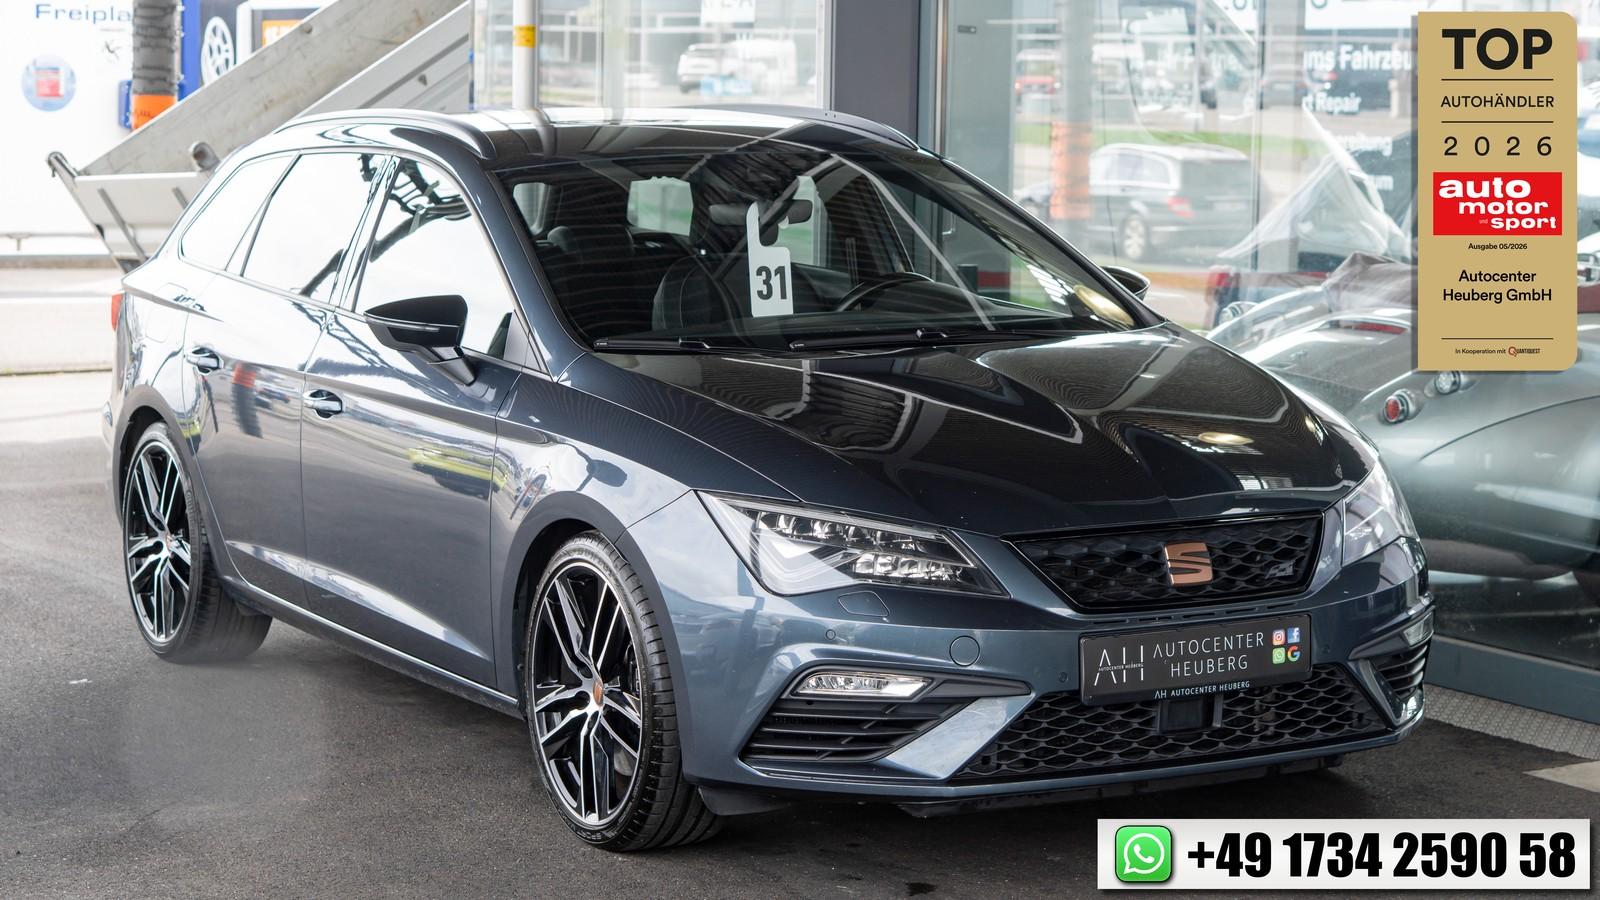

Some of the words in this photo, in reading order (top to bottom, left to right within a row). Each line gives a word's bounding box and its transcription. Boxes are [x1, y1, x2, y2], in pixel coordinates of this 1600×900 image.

[755, 265, 788, 301] 31
[1153, 632, 1264, 659] AUTOCENTER
[1171, 654, 1248, 678] HEUBERG
[1154, 690, 1167, 700] AH
[1171, 684, 1217, 697] AUTOCENTER
[1219, 681, 1250, 691] HEUBERG
